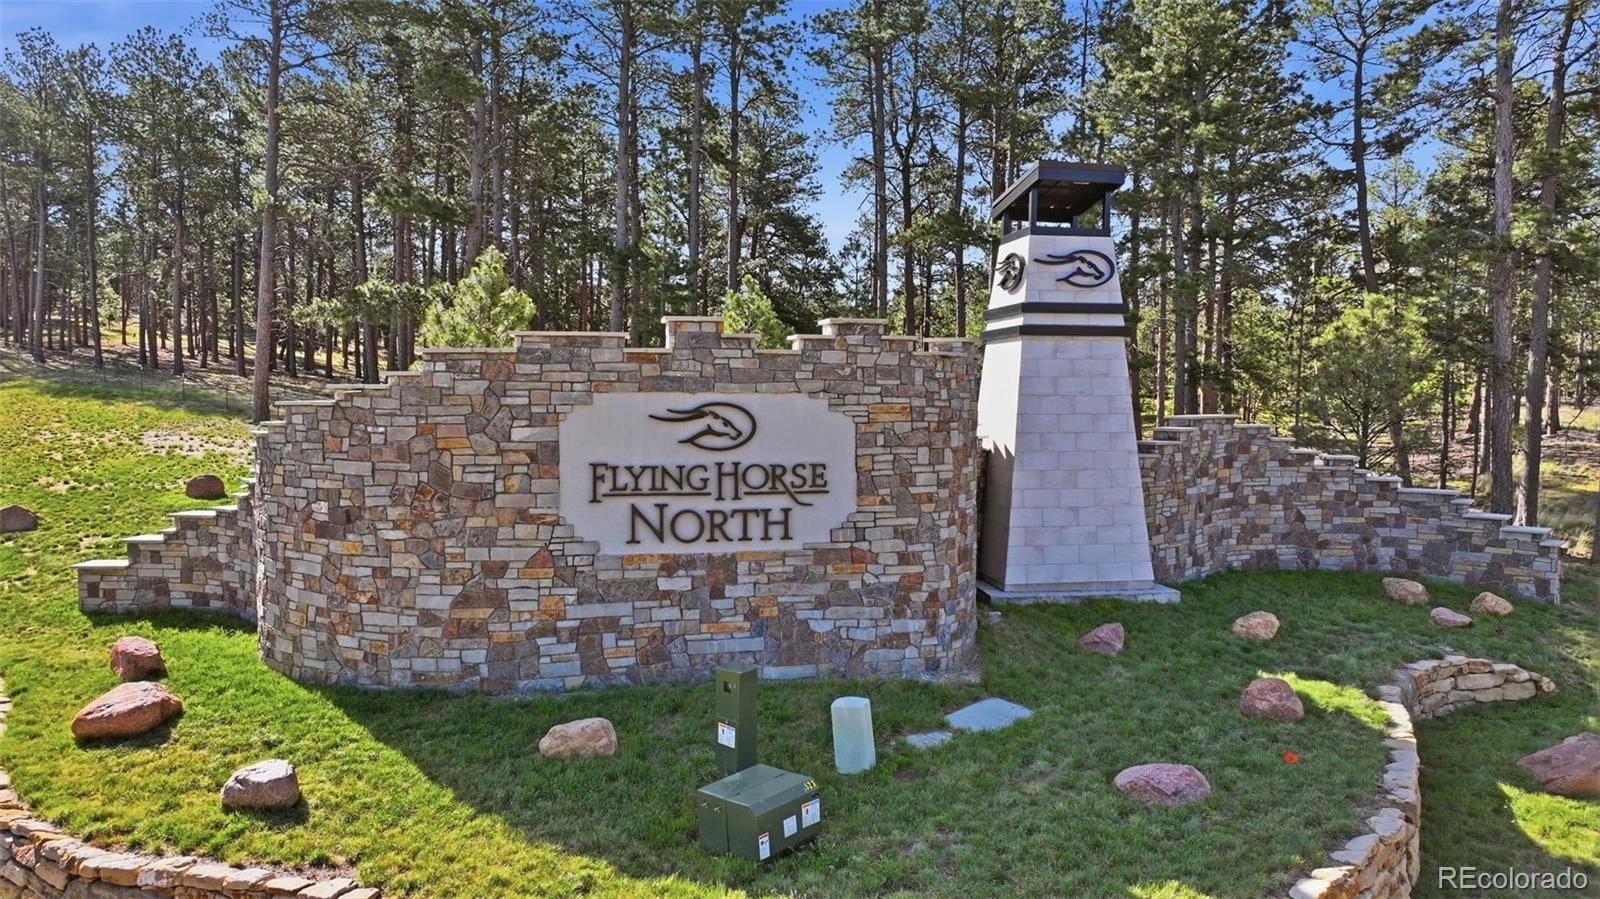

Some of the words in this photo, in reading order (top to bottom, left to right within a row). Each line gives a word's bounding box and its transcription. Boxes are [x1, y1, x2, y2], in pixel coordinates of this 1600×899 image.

[589, 462, 711, 504] FLYING
[714, 461, 829, 506] HORSE
[626, 503, 793, 544] NORTH
